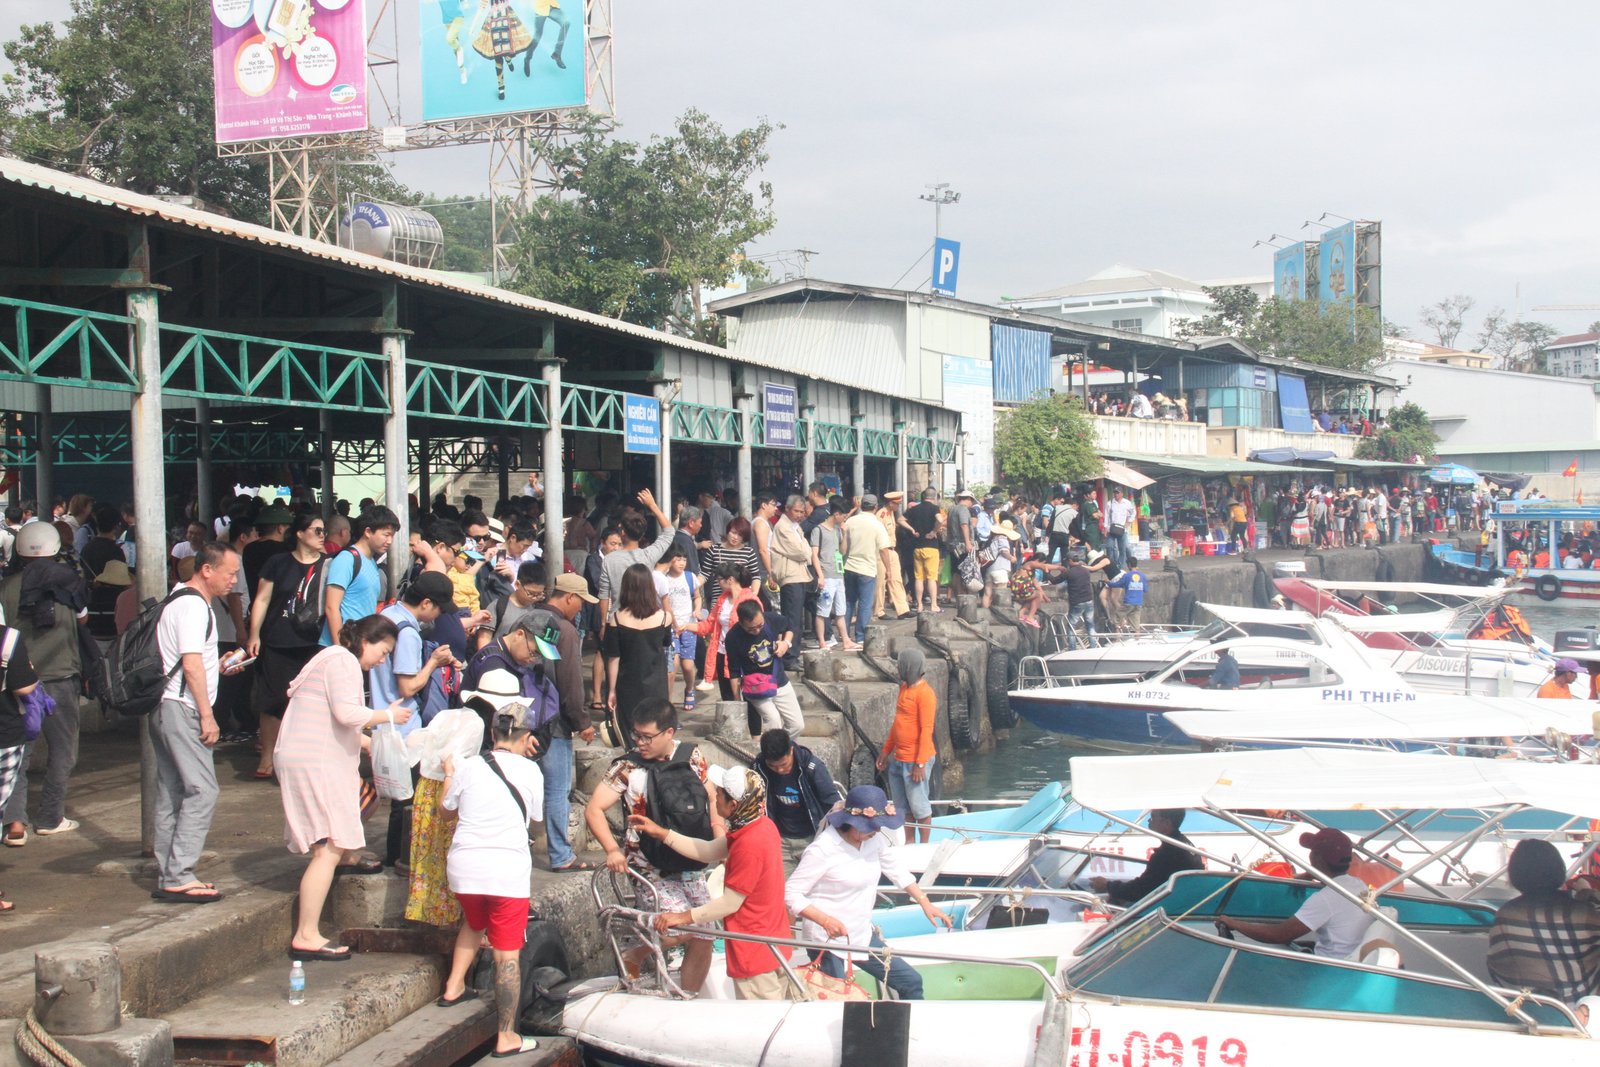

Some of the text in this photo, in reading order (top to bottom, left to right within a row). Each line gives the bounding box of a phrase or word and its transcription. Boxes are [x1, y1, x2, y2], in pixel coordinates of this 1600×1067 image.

[938, 248, 954, 285] P
[1416, 657, 1474, 673] DISCOVER
[1127, 691, 1171, 700] KH-0732
[1322, 689, 1352, 701] PHI
[1036, 1025, 1248, 1066] H-0919
